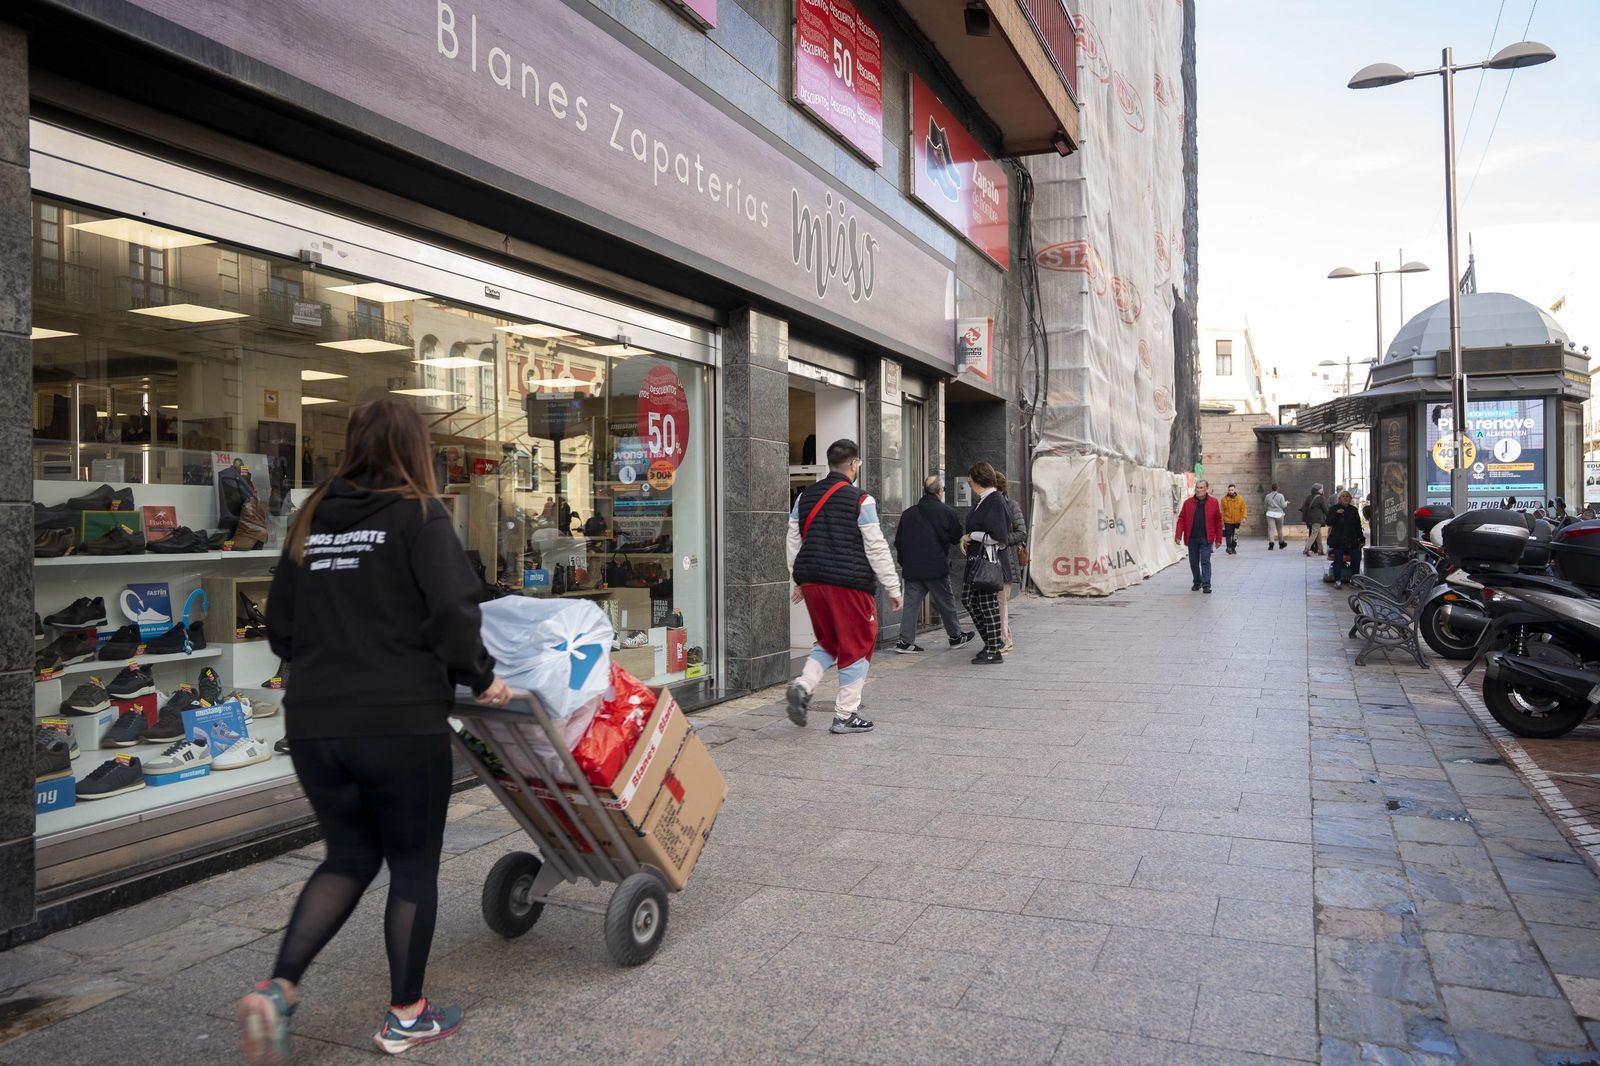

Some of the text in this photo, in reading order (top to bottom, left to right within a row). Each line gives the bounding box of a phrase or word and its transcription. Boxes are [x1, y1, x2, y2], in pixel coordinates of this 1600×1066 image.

[437, 0, 770, 228] Blanes Zapaterías
[972, 158, 999, 206] Zapato
[1476, 418, 1535, 430] renove
[333, 530, 387, 545] DEPORTE
[632, 743, 657, 788] Blanes
